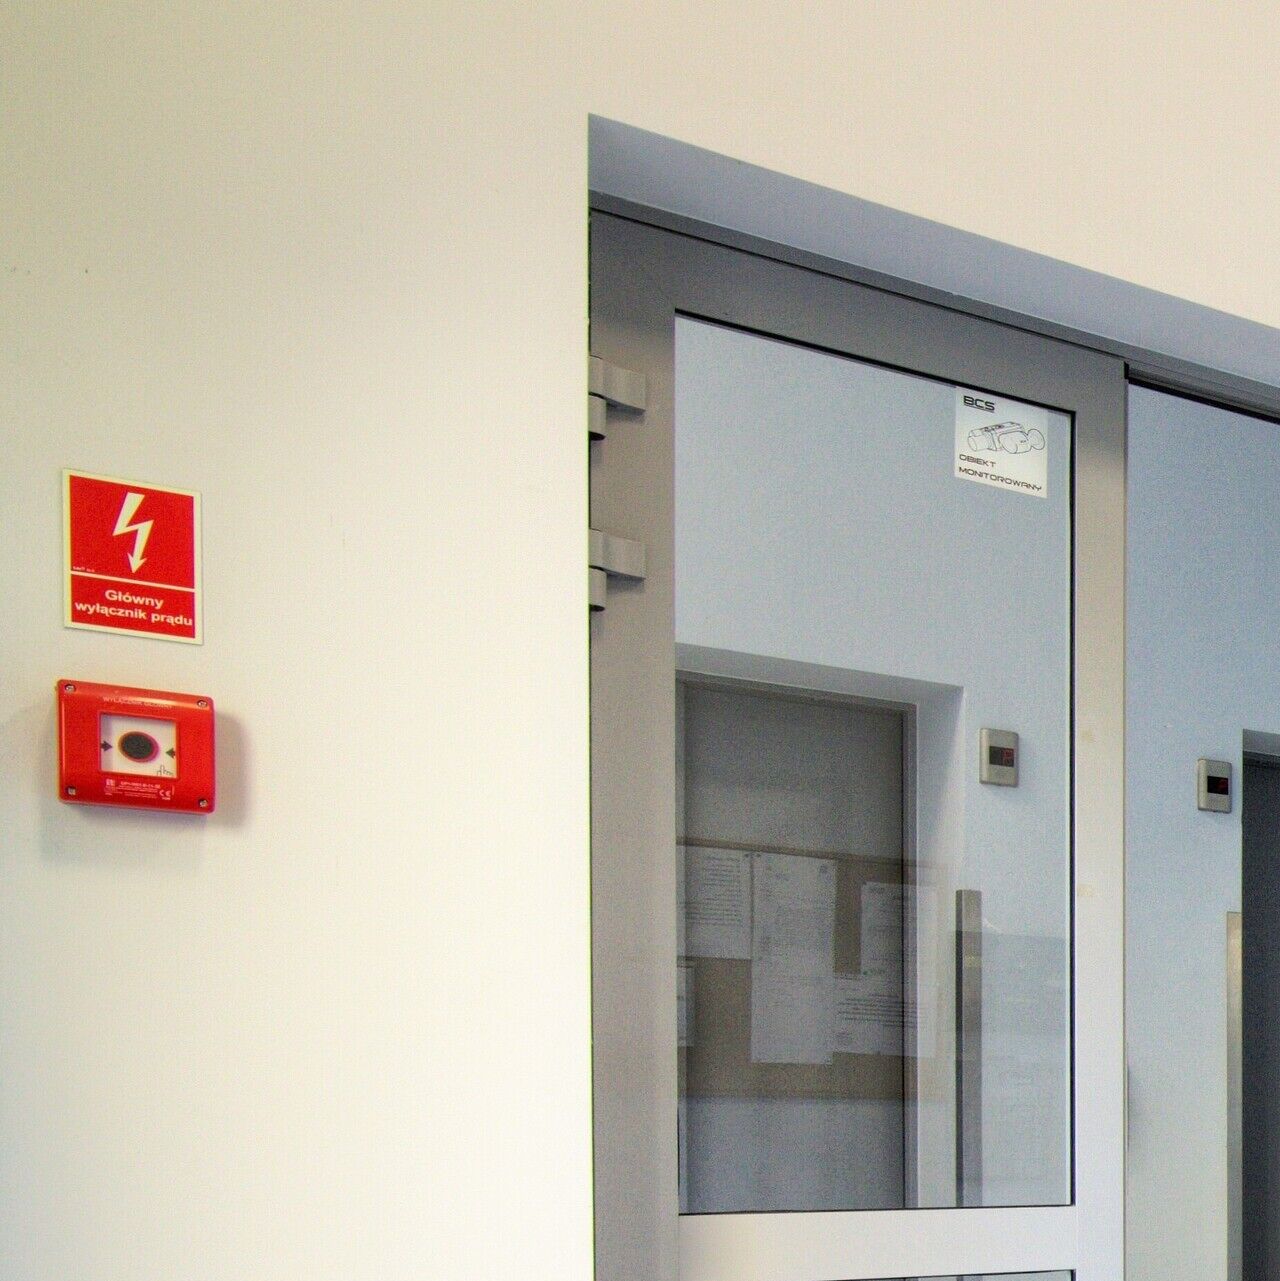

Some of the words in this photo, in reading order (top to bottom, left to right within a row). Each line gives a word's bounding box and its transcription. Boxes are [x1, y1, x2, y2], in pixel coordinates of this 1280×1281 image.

[963, 396, 995, 412] BCS
[959, 453, 997, 468] OBIEKT
[958, 466, 1042, 492] MONITOROWANY
[104, 589, 164, 609] Główny
[74, 602, 147, 621] wyłącznik
[150, 612, 193, 627] prądu
